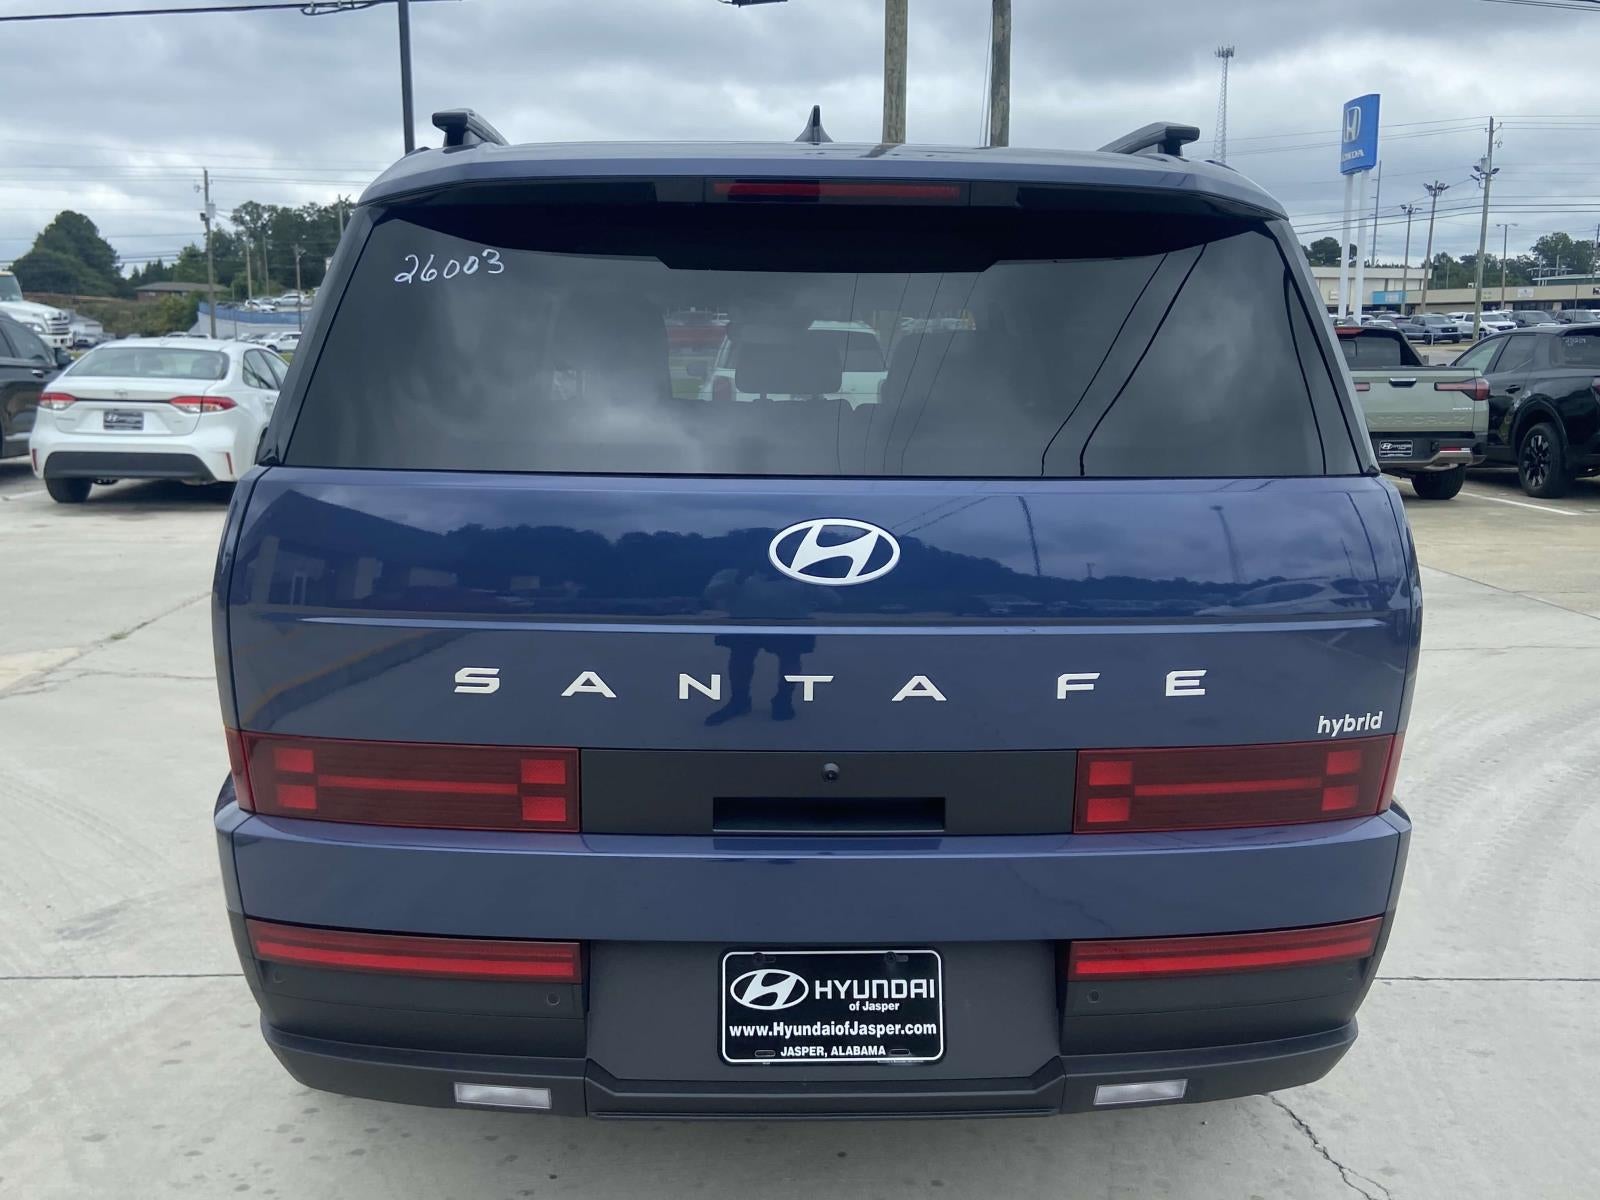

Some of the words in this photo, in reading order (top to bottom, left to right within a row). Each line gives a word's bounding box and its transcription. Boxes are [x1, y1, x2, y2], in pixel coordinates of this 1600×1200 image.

[394, 248, 505, 284] 26003
[453, 666, 948, 702] SANTA
[1056, 669, 1208, 700] FE
[1317, 711, 1384, 738] hybrid
[814, 978, 936, 1000] HYUNDAI
[848, 1000, 861, 1012] of
[861, 1000, 901, 1013] Jasper
[728, 1020, 938, 1039] www.HyundaiofJasper.com
[779, 1045, 829, 1058] JASPER,
[830, 1045, 887, 1057] ALABAMA
